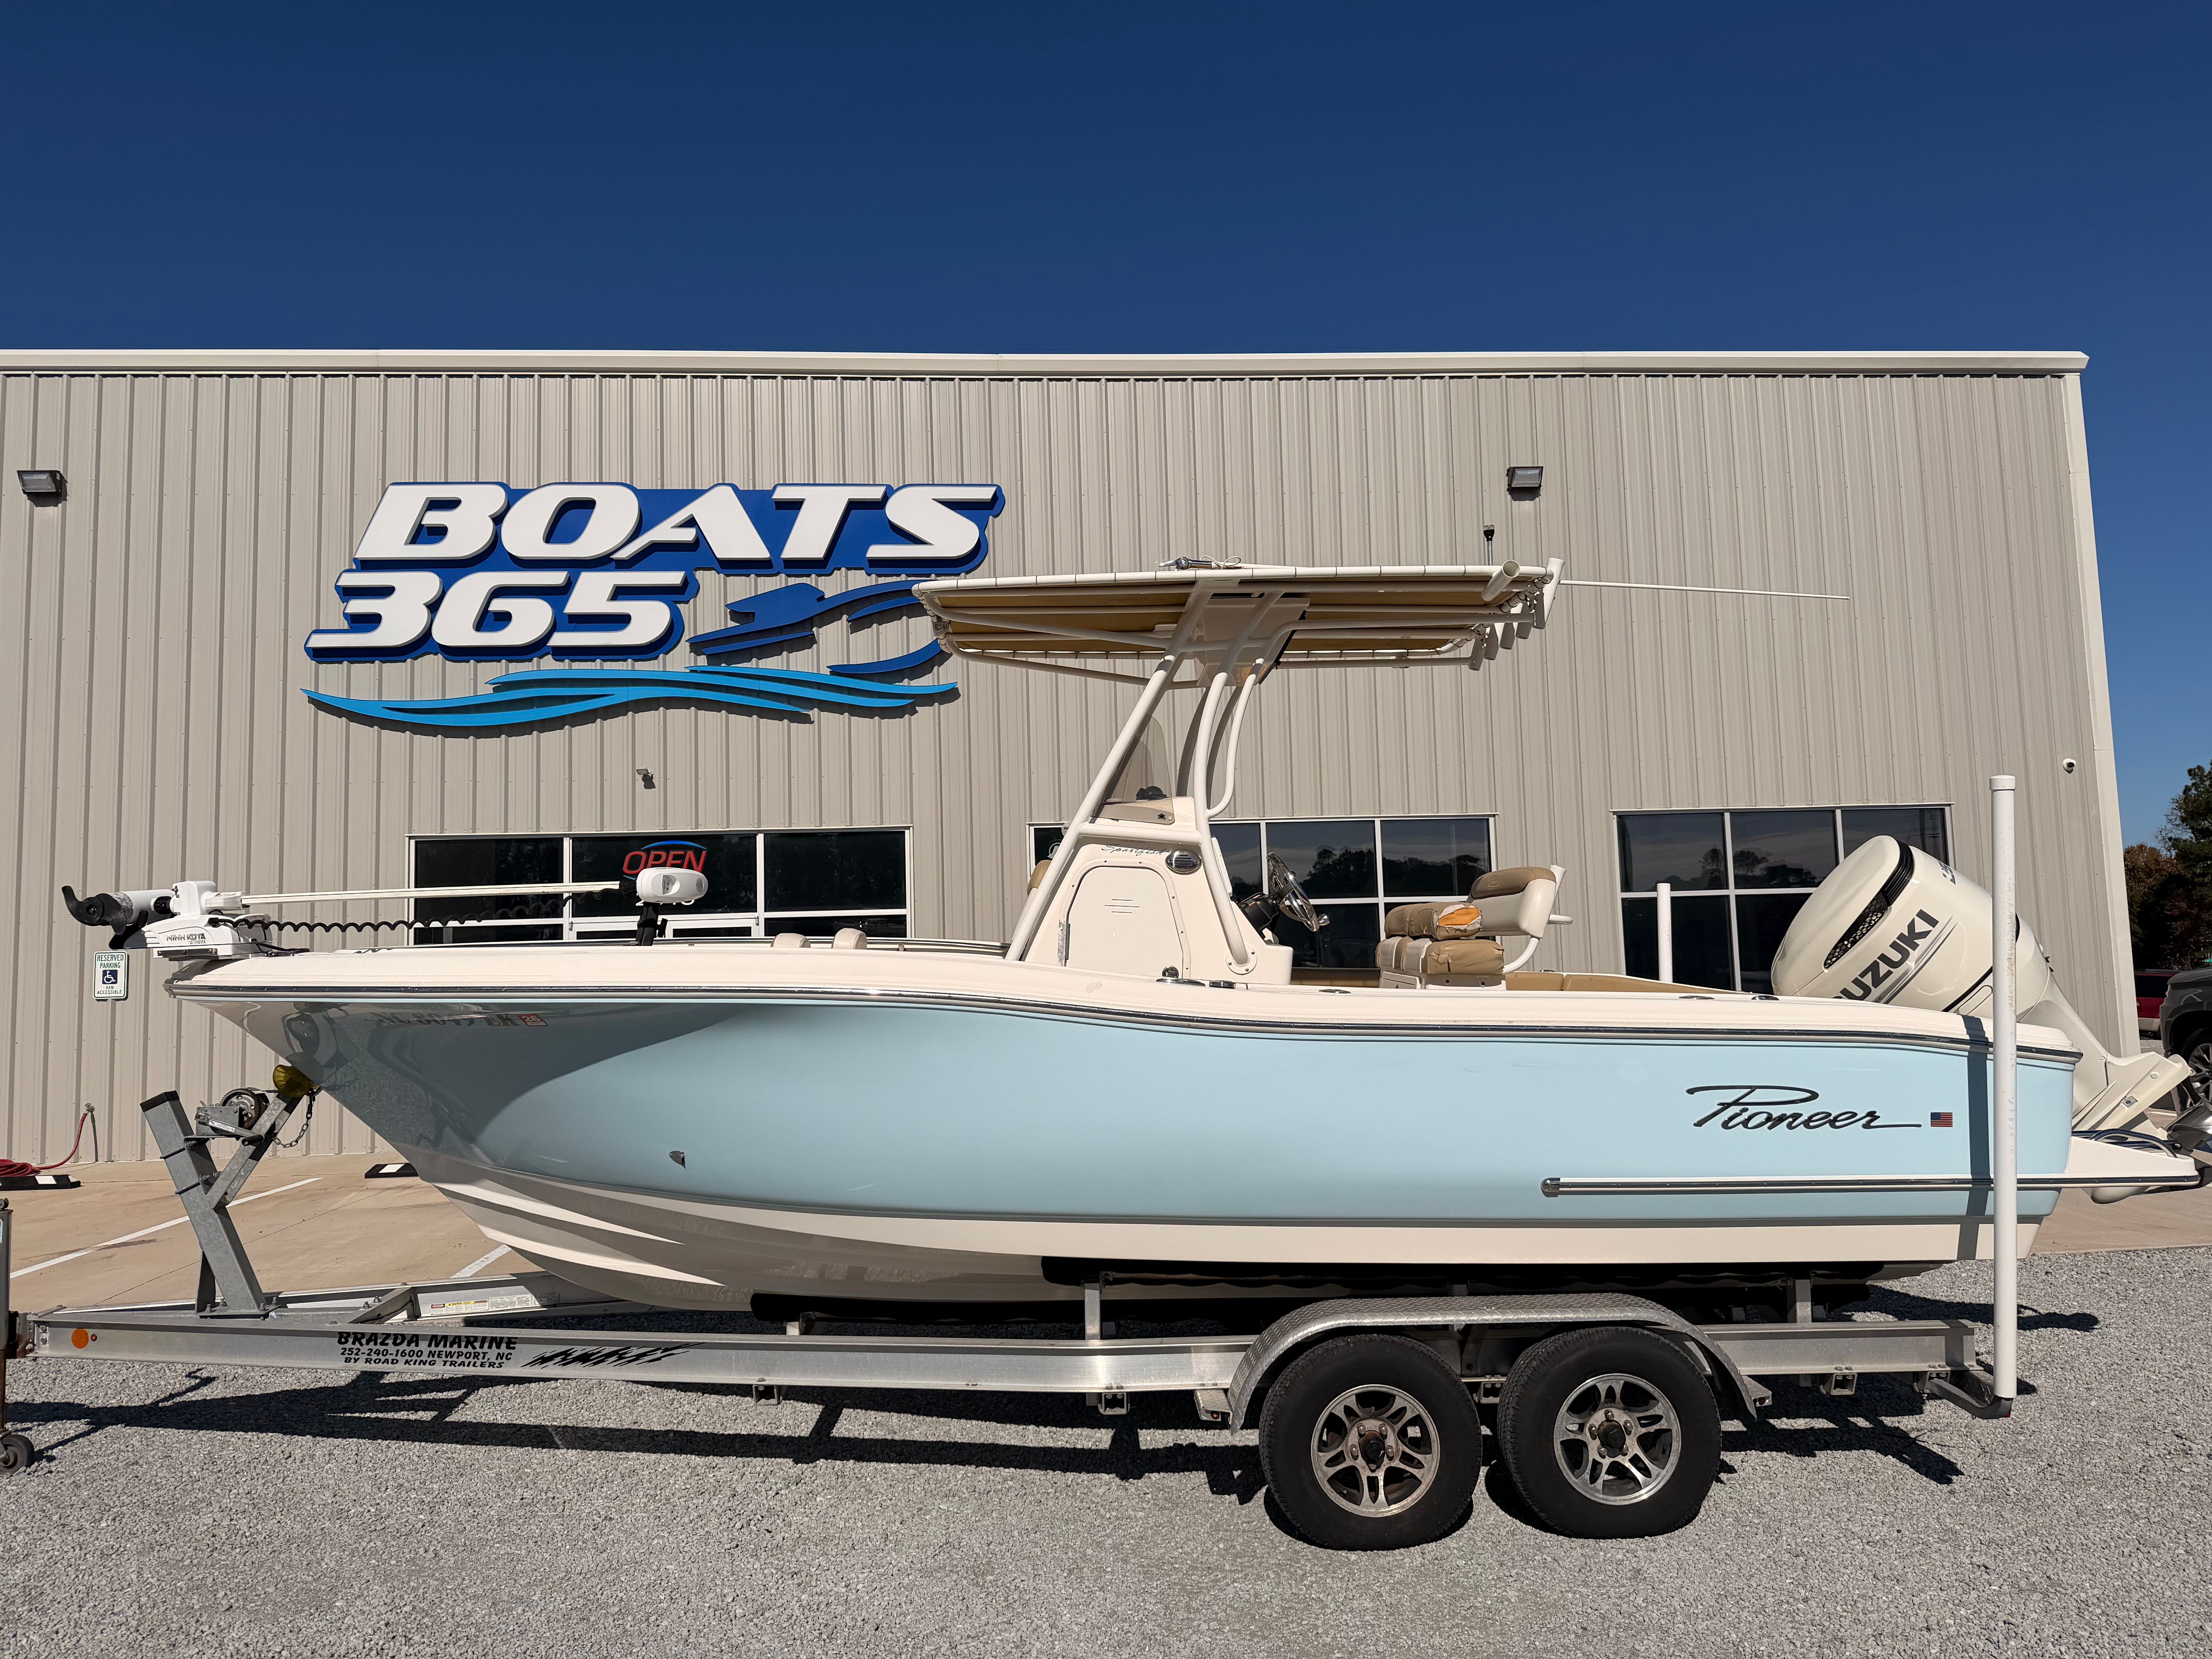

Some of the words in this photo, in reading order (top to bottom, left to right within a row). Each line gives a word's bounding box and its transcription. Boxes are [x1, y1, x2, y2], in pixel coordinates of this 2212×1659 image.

[353, 482, 998, 562] BOATS
[307, 571, 688, 649] 365
[1832, 908, 1939, 1001] UZUKI
[1685, 1085, 1922, 1130] Pioneer
[337, 1331, 419, 1347] BRAZDA
[427, 1334, 519, 1350] MARINE
[340, 1347, 423, 1358] 252-240-1600
[427, 1350, 491, 1362] NEWPORT,
[495, 1352, 512, 1360] NC
[442, 1360, 504, 1369] TRAILERS
